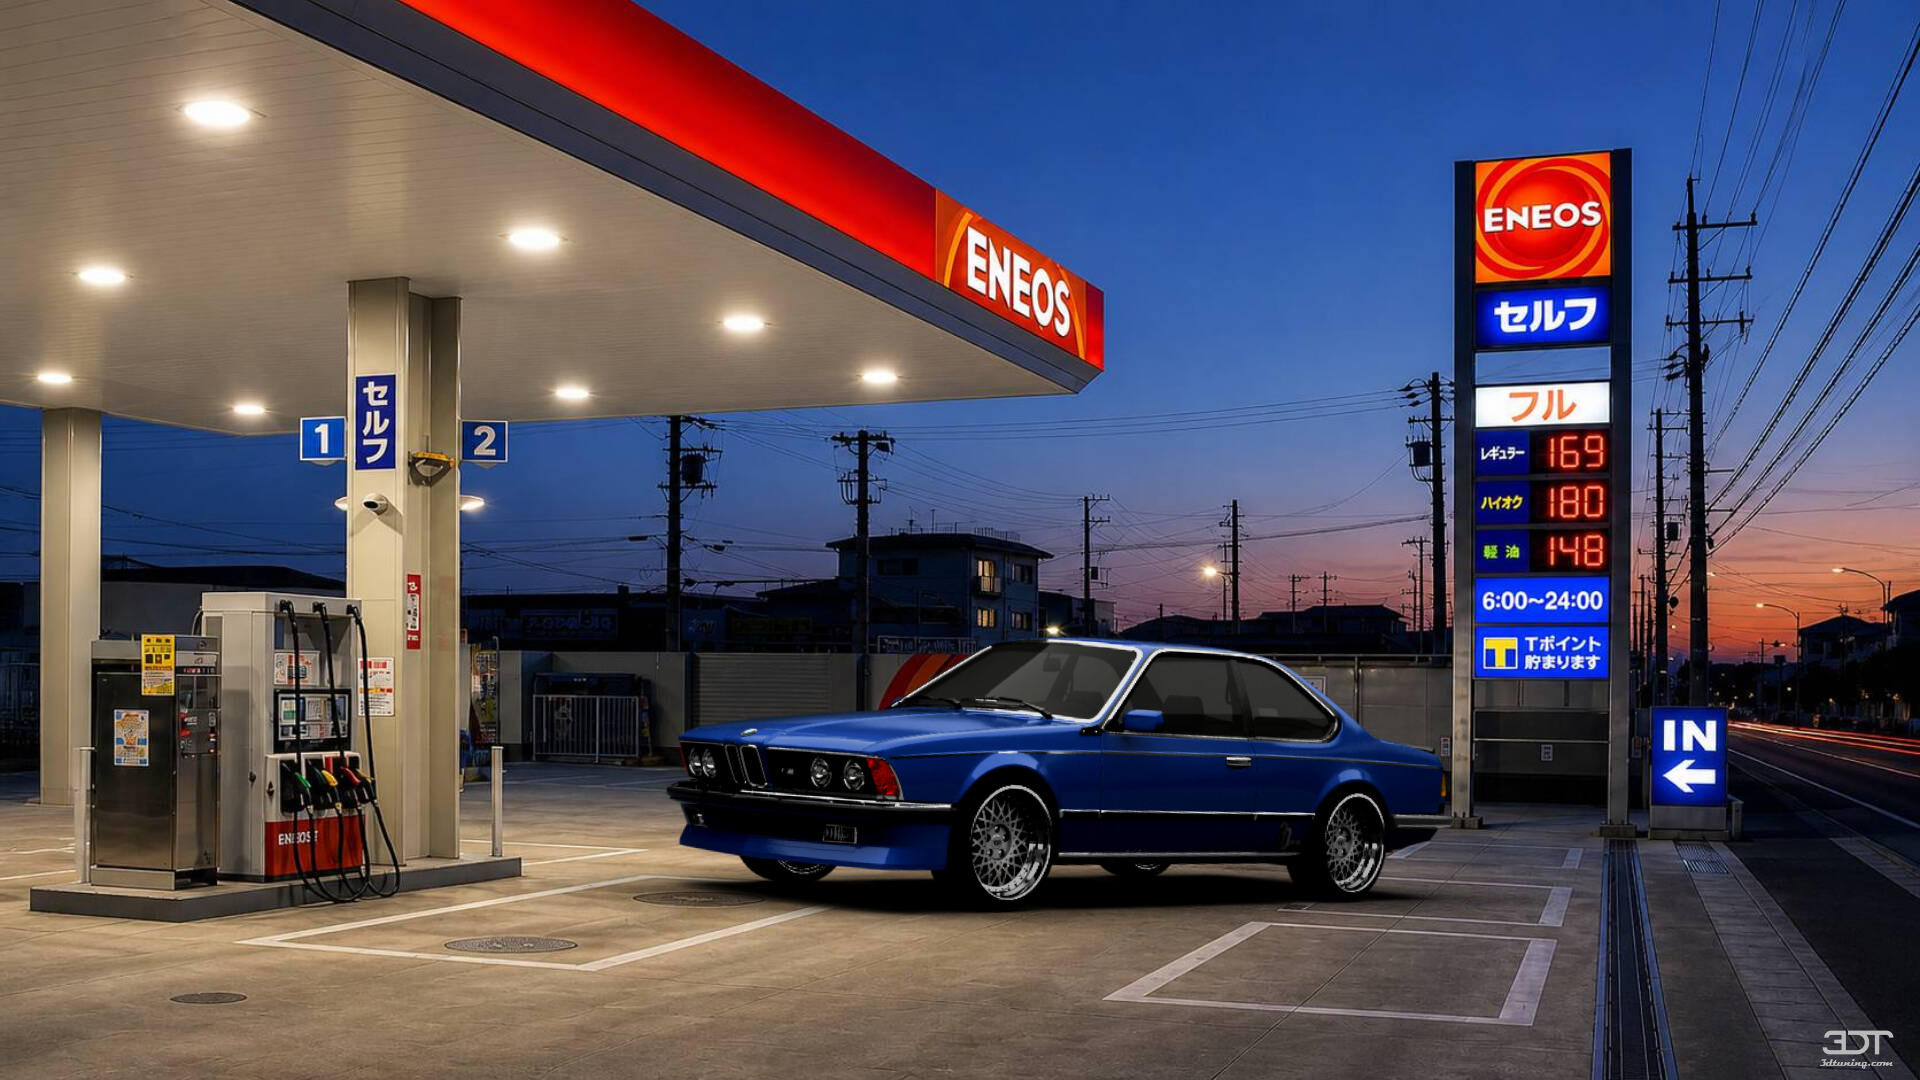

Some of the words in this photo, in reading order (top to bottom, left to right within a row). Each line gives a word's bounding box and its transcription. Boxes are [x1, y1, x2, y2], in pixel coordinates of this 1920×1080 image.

[1484, 201, 1602, 233] ENEOS
[967, 225, 1070, 337] ENEOS
[1494, 297, 1597, 333] セルフ
[1508, 388, 1576, 422] フル
[314, 423, 329, 454] 1
[362, 381, 390, 464] セルフ
[473, 425, 496, 456] 2
[1481, 446, 1525, 461] レギュラー
[1550, 435, 1604, 468] 169
[1481, 495, 1523, 510] ハイオク
[1550, 485, 1604, 518] 180
[1550, 535, 1604, 567] 148
[1524, 636, 1602, 652] Tポイント
[1524, 655, 1601, 670] 貯まります
[1663, 720, 1717, 752] IN
